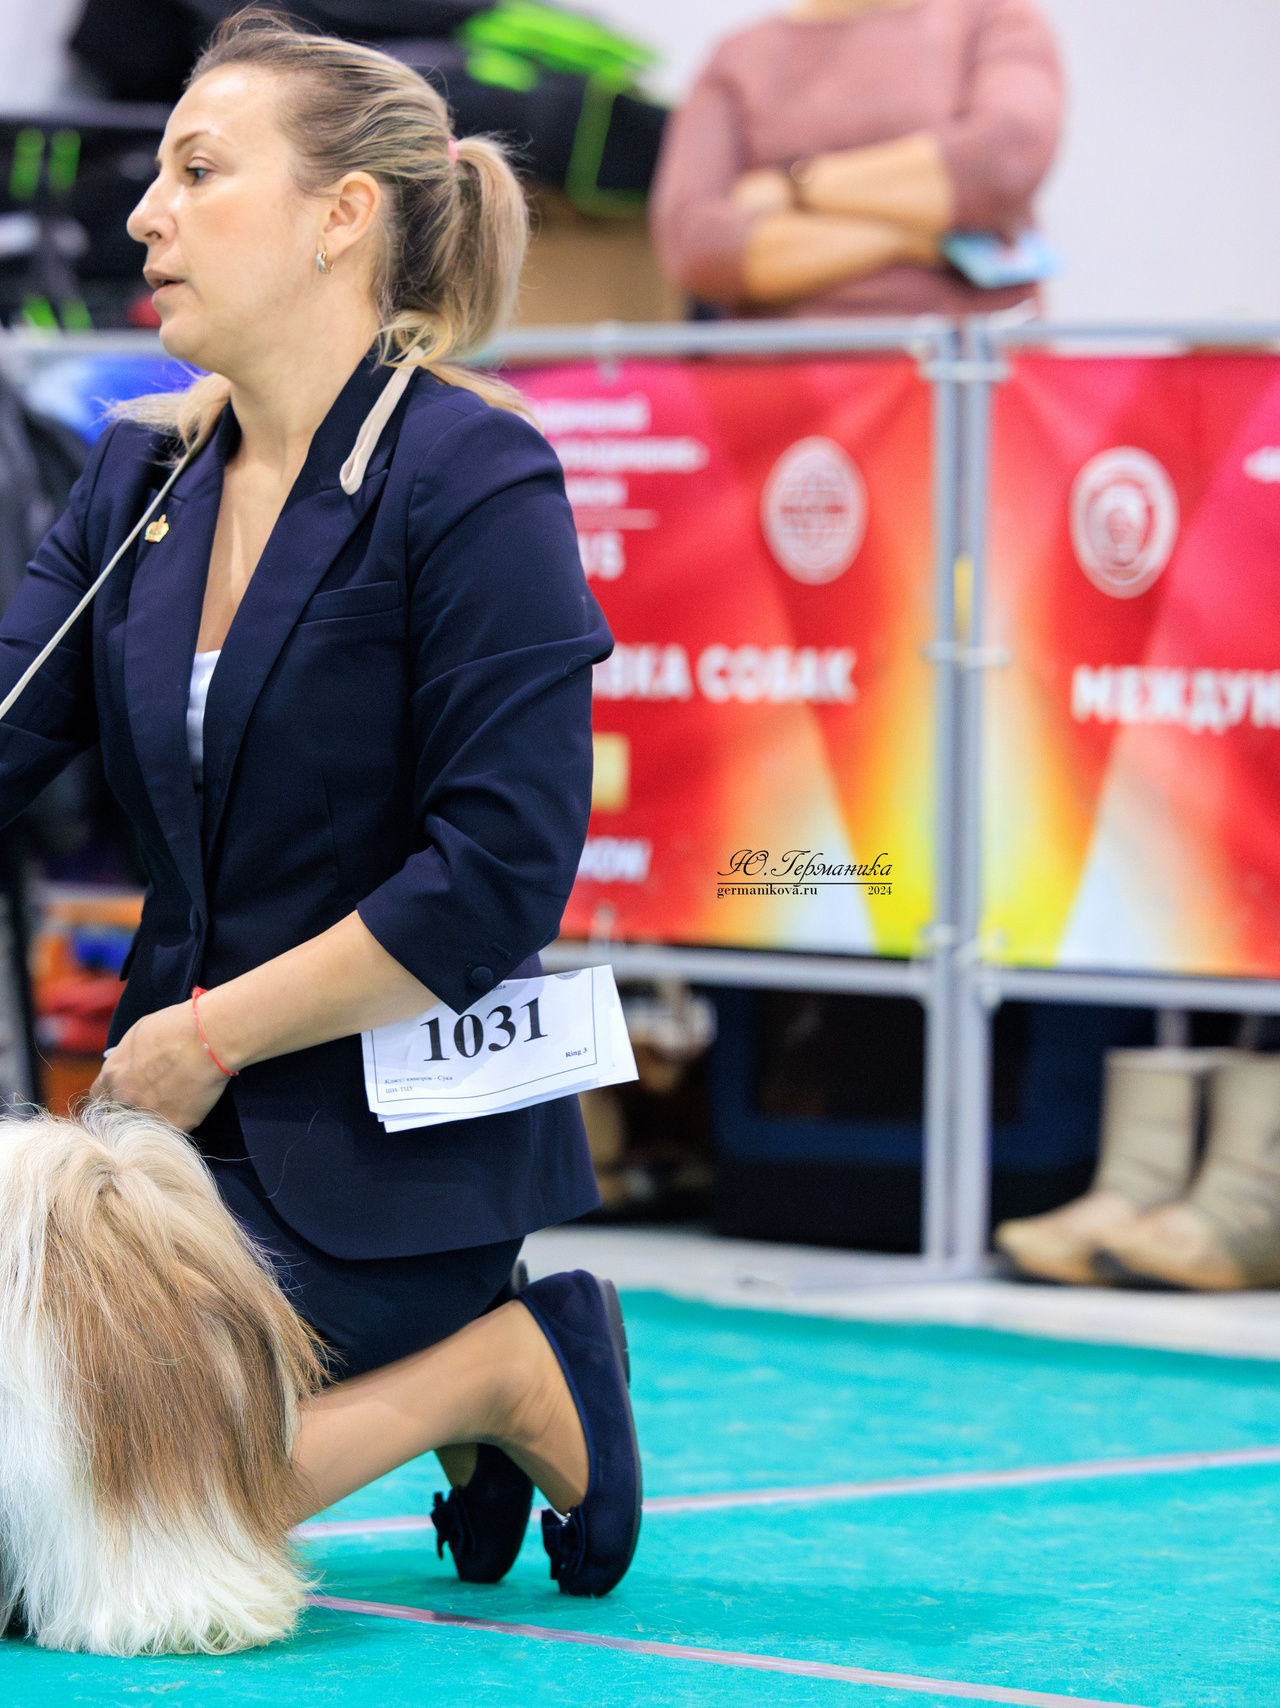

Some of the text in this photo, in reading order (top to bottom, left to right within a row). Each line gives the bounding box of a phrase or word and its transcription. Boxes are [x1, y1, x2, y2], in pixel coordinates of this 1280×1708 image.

[696, 644, 857, 704] СОБАК
[420, 997, 548, 1062] 1031
[565, 1050, 582, 1058] Ring
